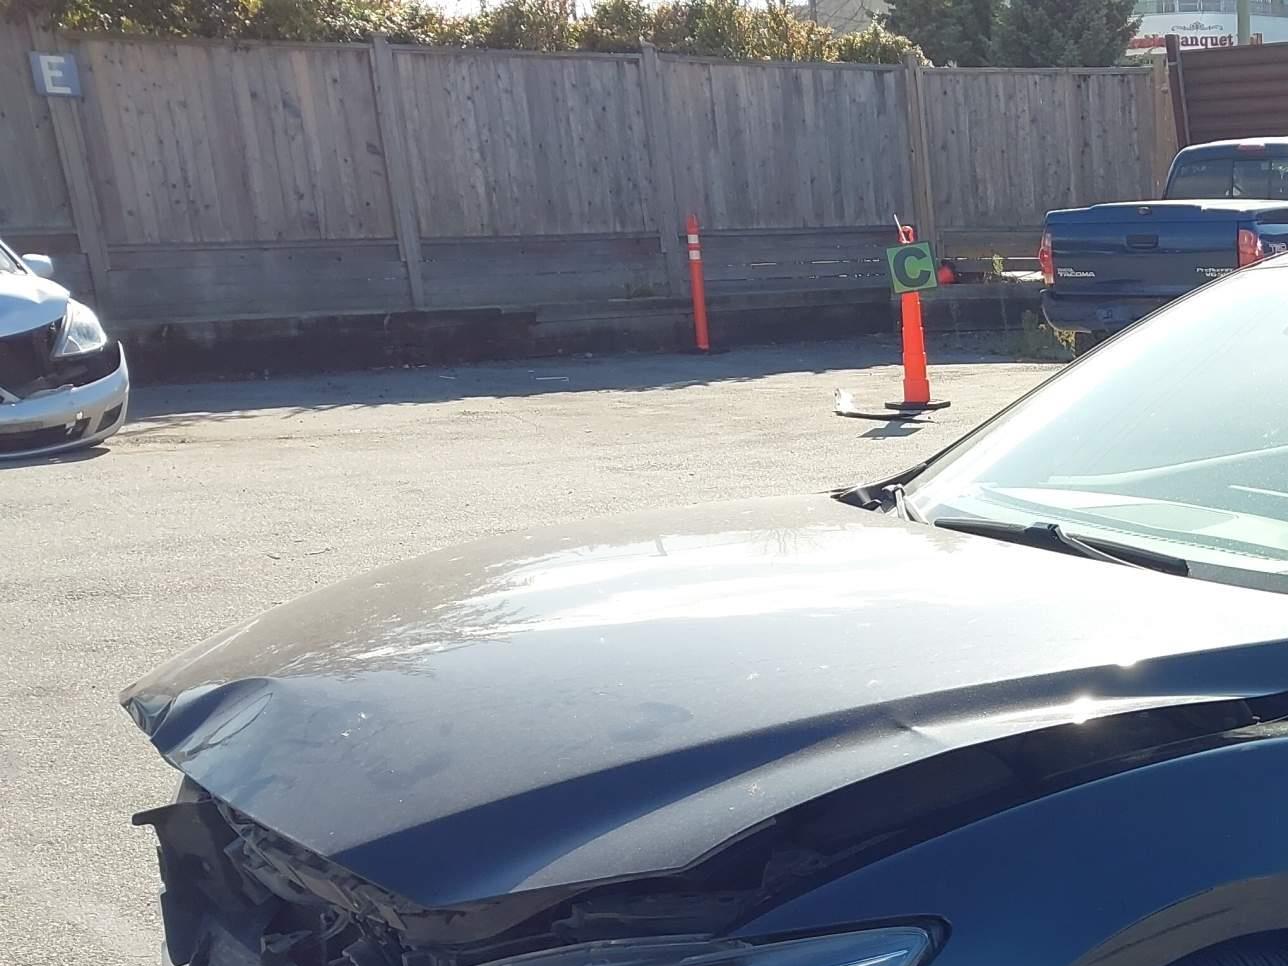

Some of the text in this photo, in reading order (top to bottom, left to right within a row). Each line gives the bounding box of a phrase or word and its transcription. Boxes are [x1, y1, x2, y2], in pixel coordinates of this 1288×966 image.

[1180, 33, 1234, 48] anquet
[40, 55, 72, 94] E
[893, 247, 931, 288] C
